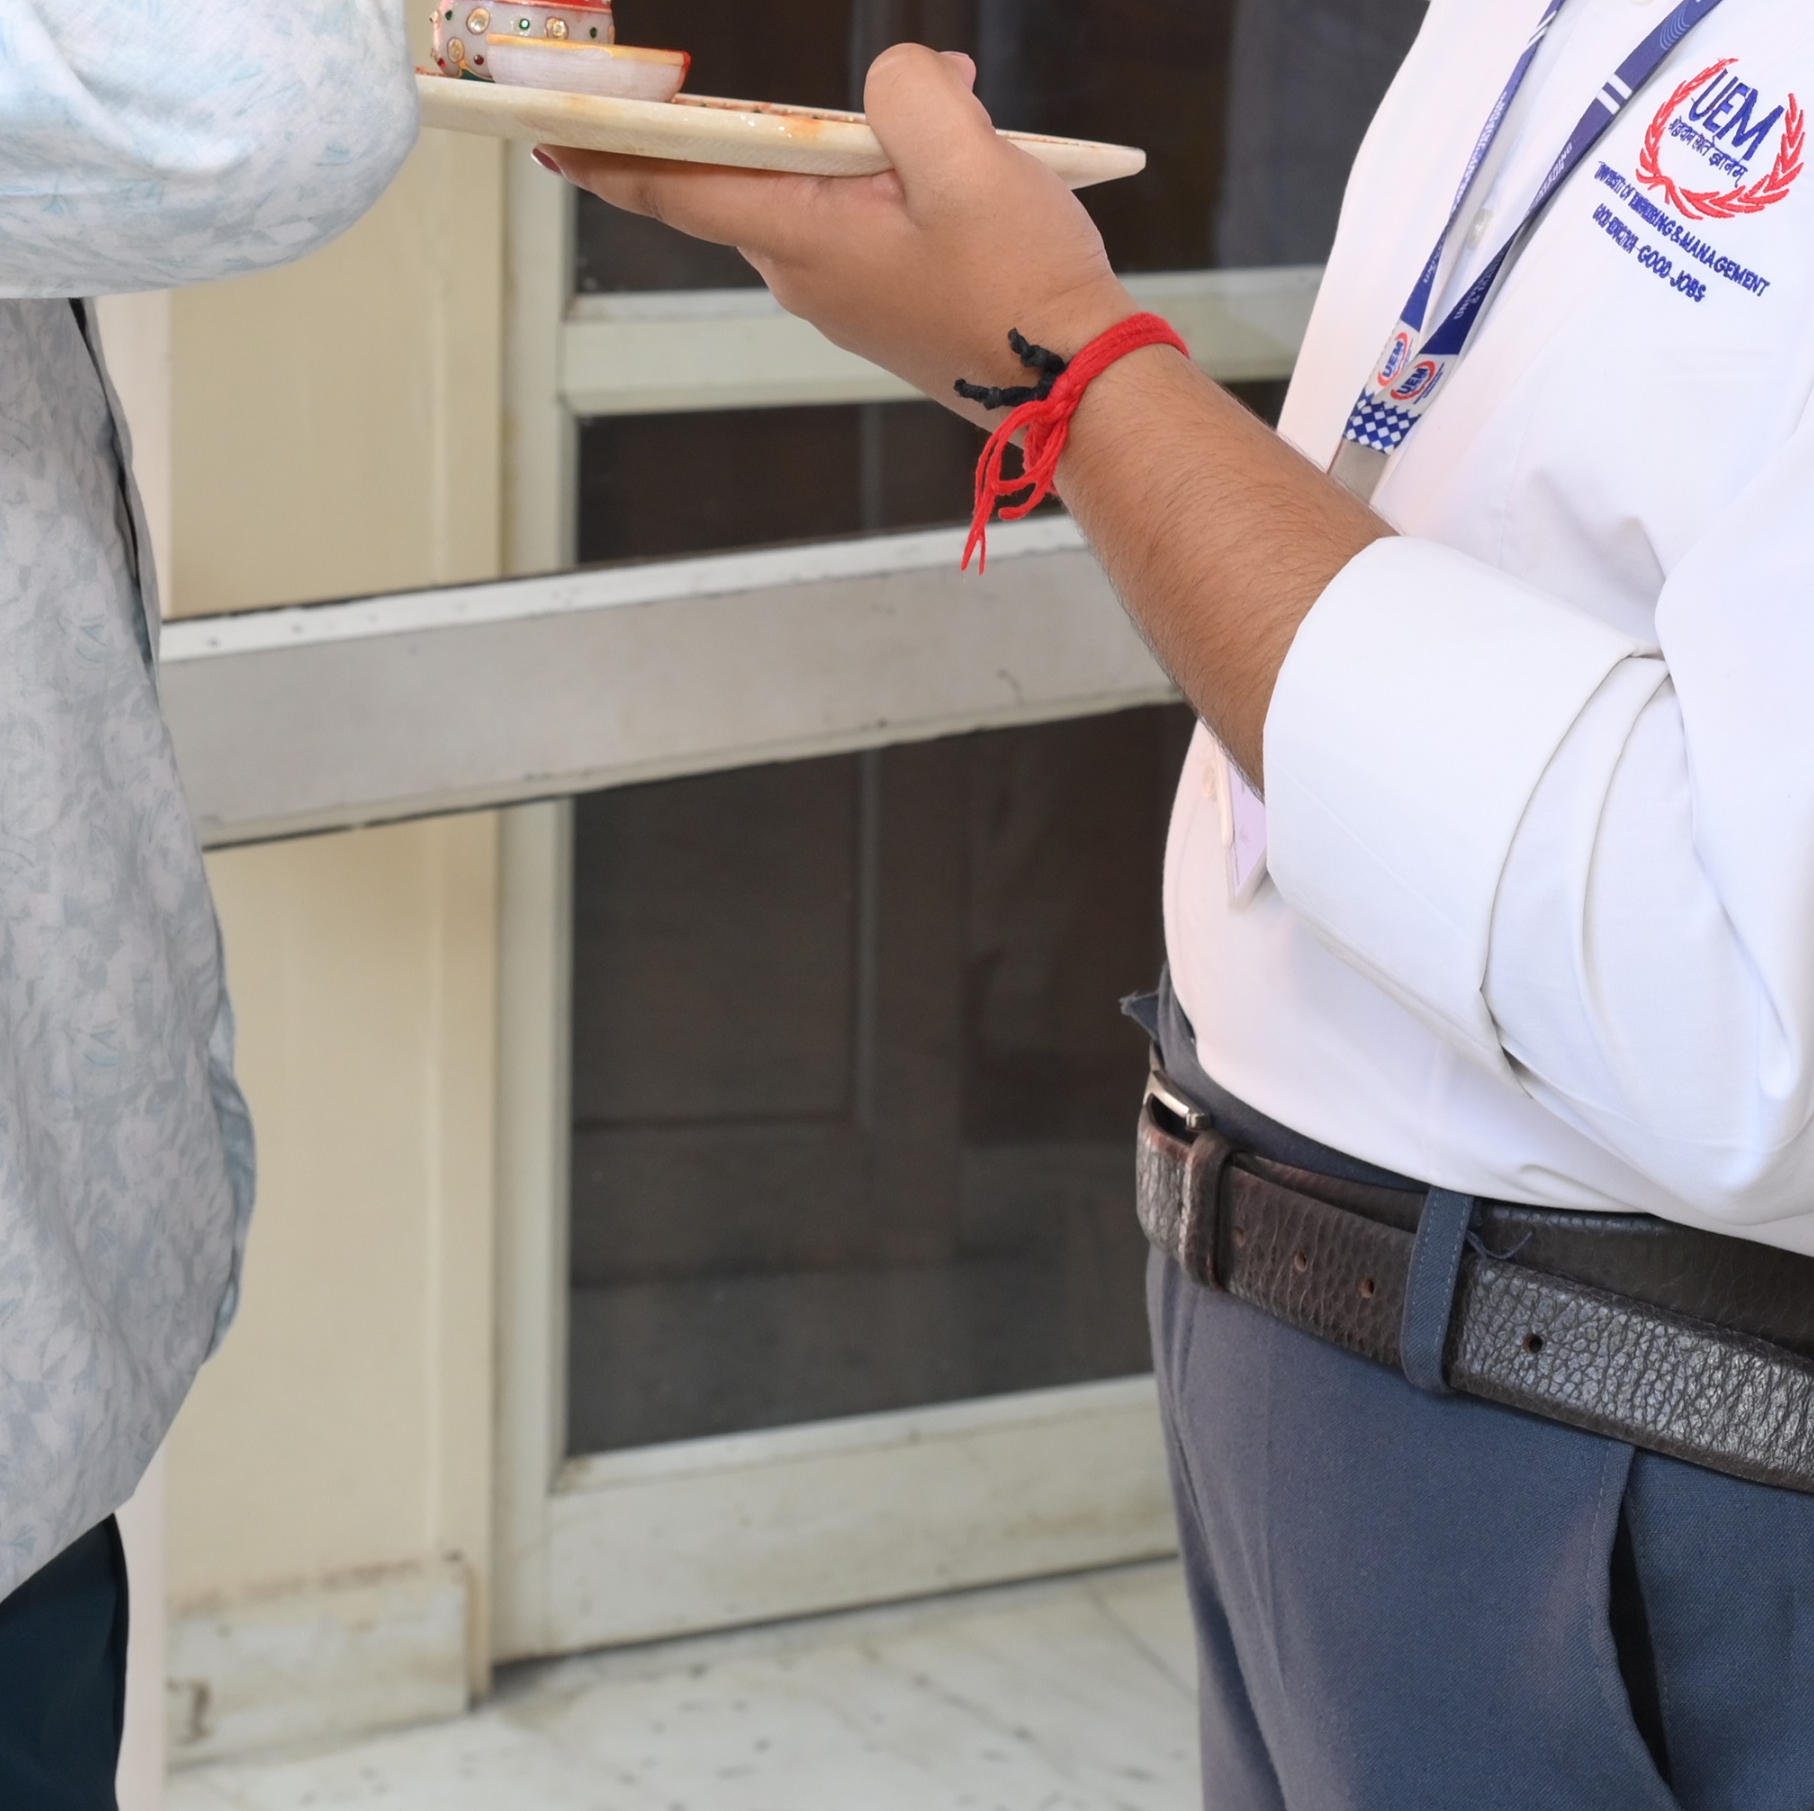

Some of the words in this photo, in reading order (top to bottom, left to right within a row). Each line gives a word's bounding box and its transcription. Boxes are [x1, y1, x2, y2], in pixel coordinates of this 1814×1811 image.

[1688, 68, 1785, 161] UEM
[1679, 230, 1771, 297] MANAGEMENT
[1382, 340, 1404, 378] UEM
[1396, 367, 1429, 395] UEM
